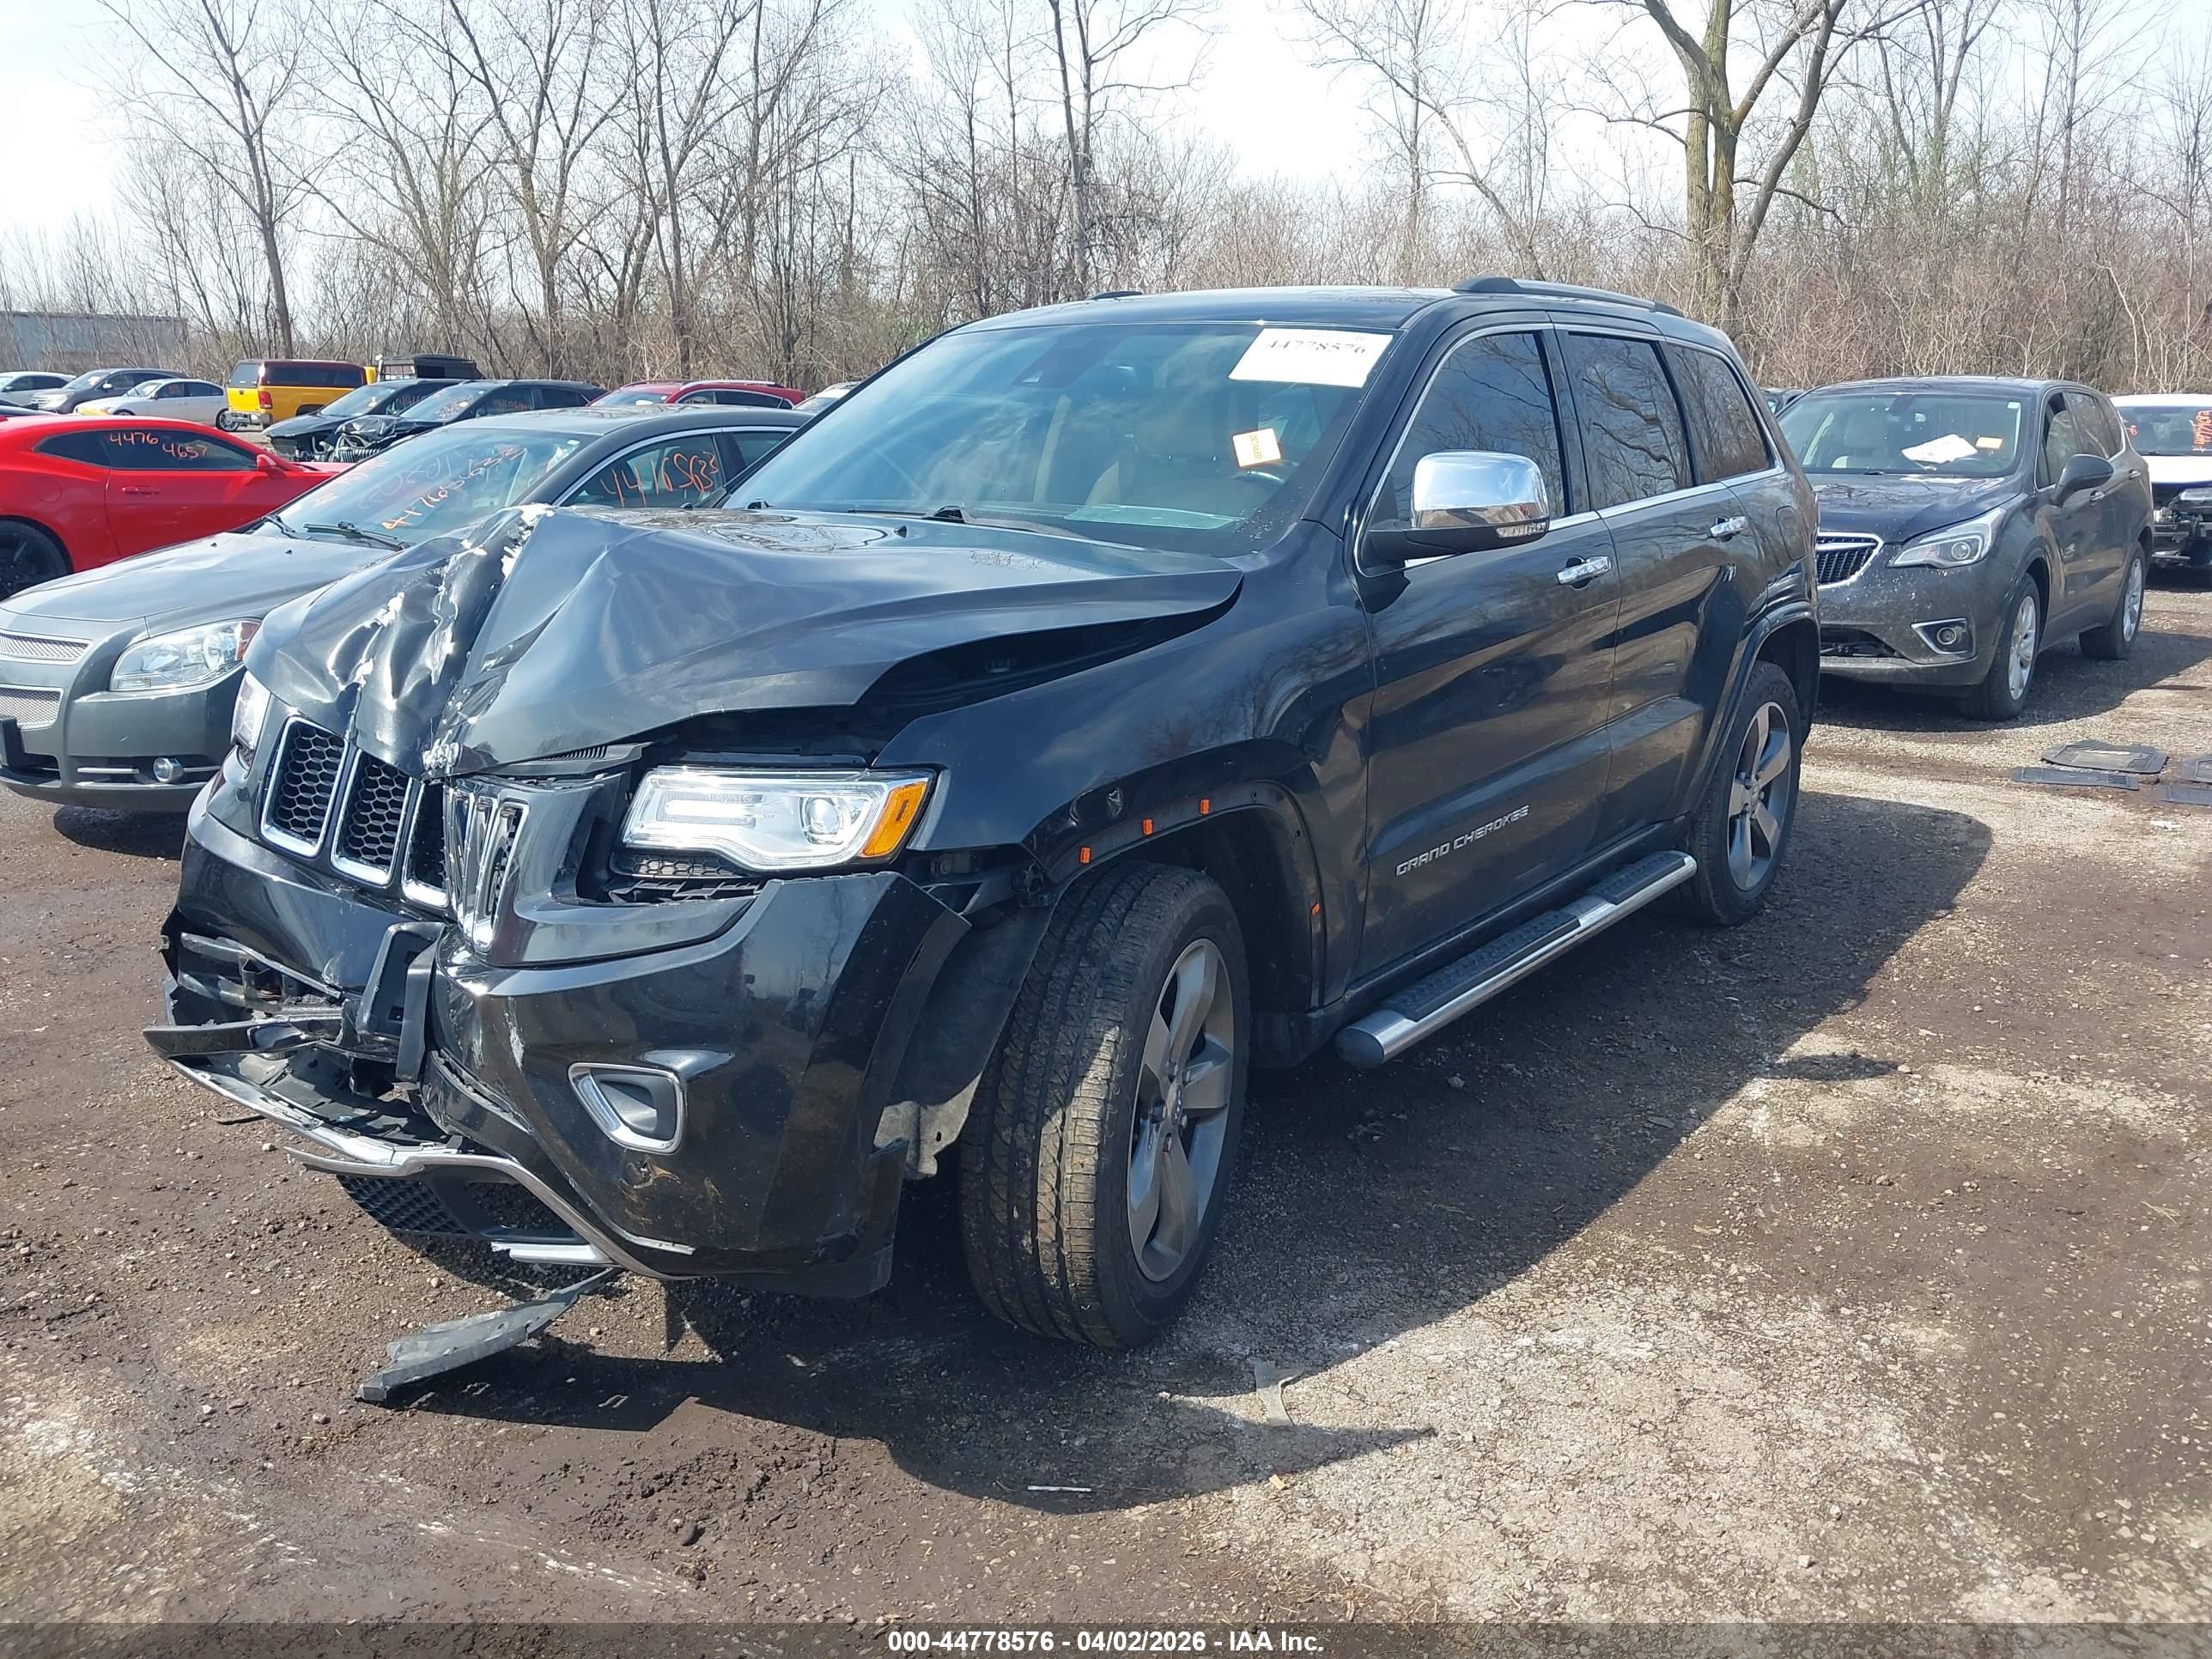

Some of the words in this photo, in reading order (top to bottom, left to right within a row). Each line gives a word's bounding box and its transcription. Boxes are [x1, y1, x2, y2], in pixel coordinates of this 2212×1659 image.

[110, 432, 159, 447] 4476
[162, 443, 207, 459] 4657
[1395, 842, 1450, 876] GRAND
[1453, 805, 1530, 849] CHEROKEE
